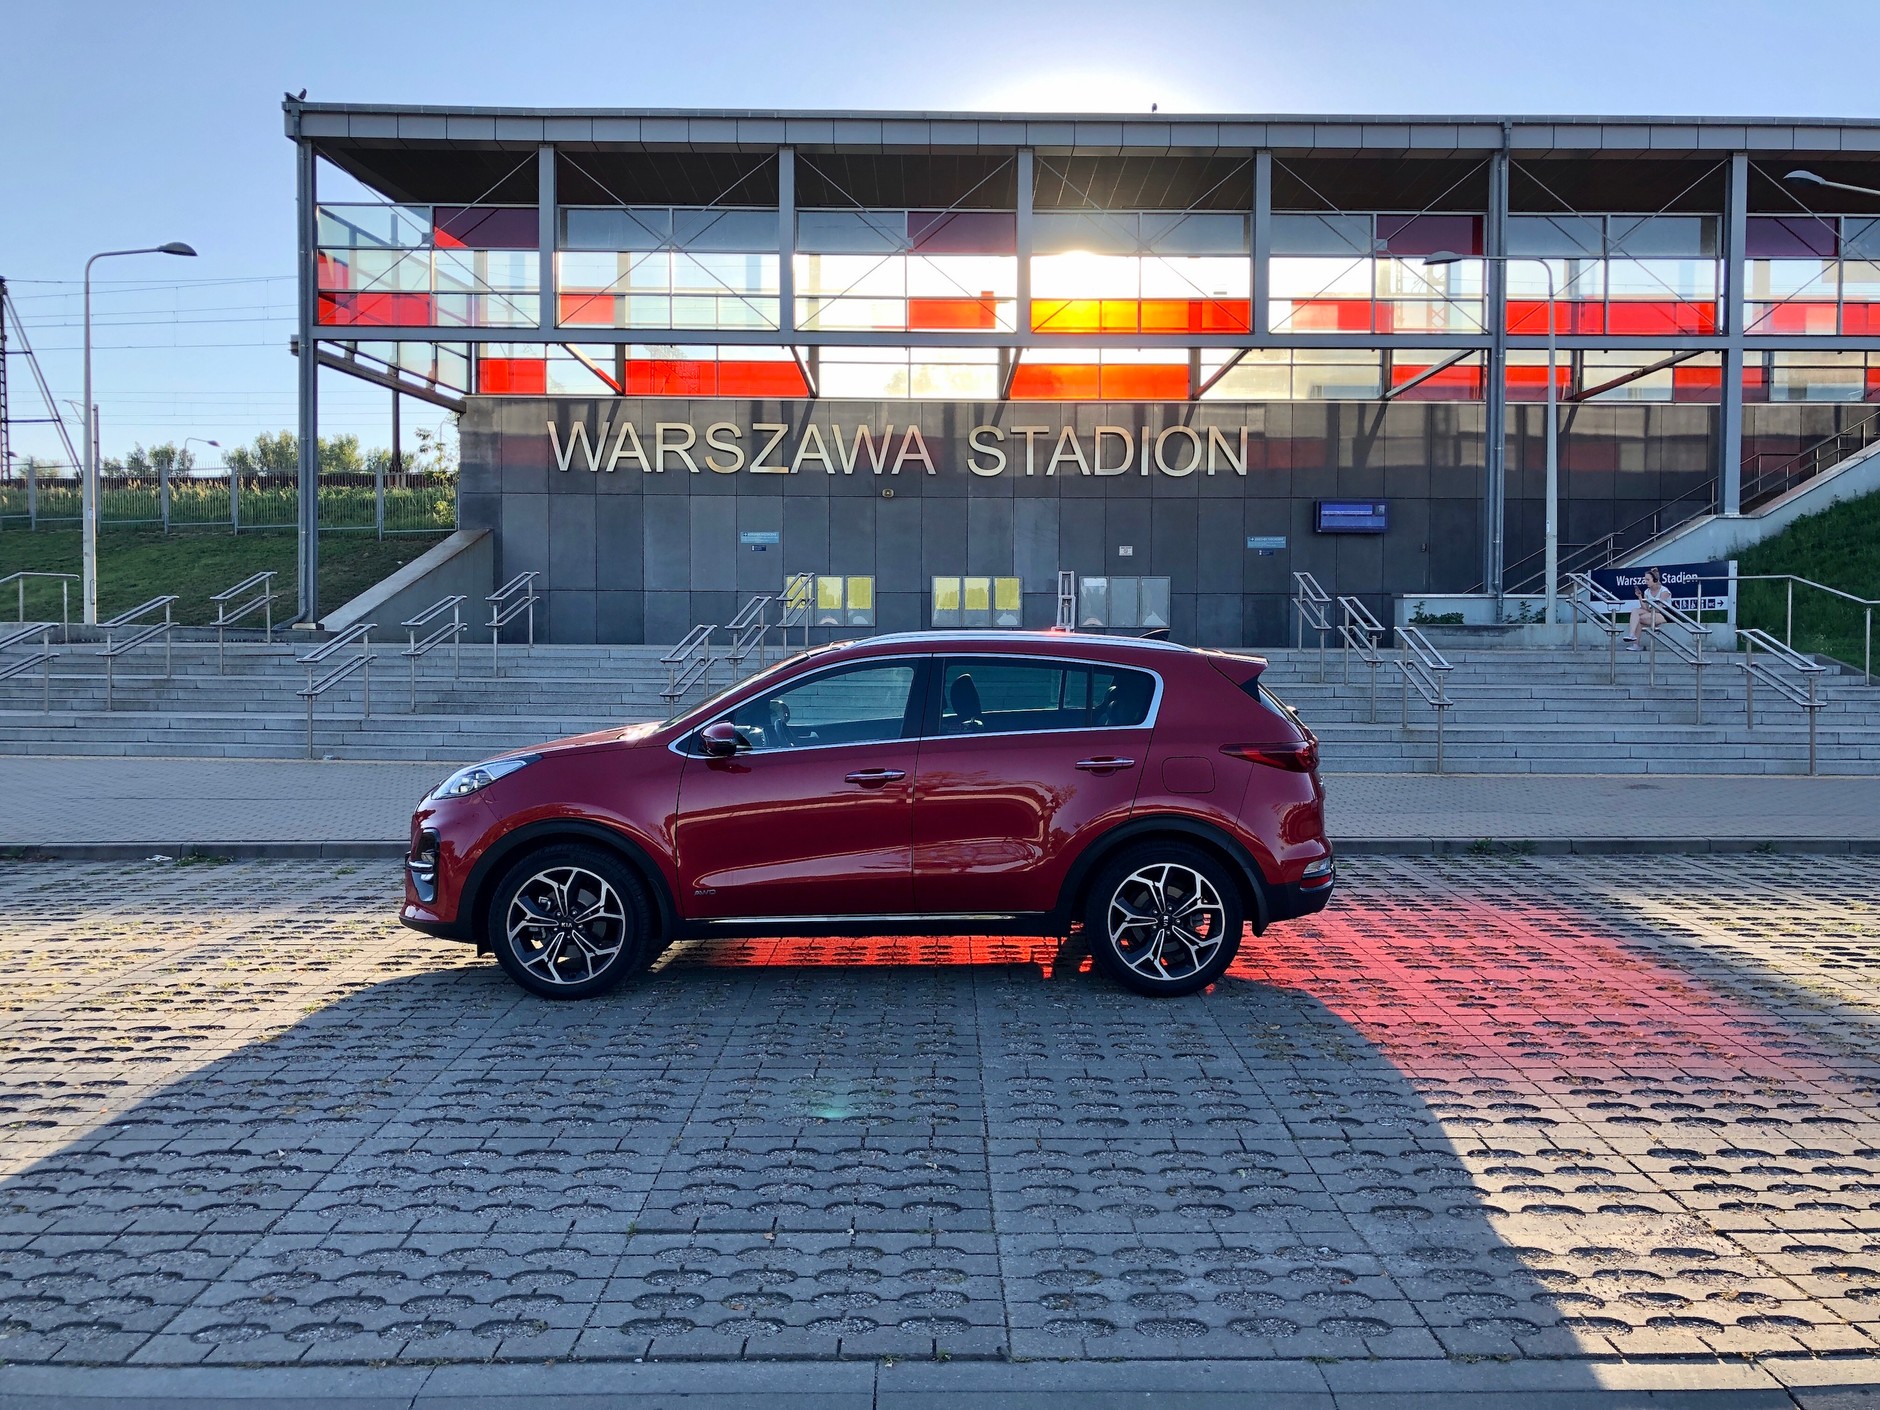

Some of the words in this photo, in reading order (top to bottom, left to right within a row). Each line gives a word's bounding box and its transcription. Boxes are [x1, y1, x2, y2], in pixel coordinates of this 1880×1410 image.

[546, 420, 937, 476] WARSZAWA
[966, 424, 1249, 478] STADION
[1616, 575, 1648, 586] Warsza
